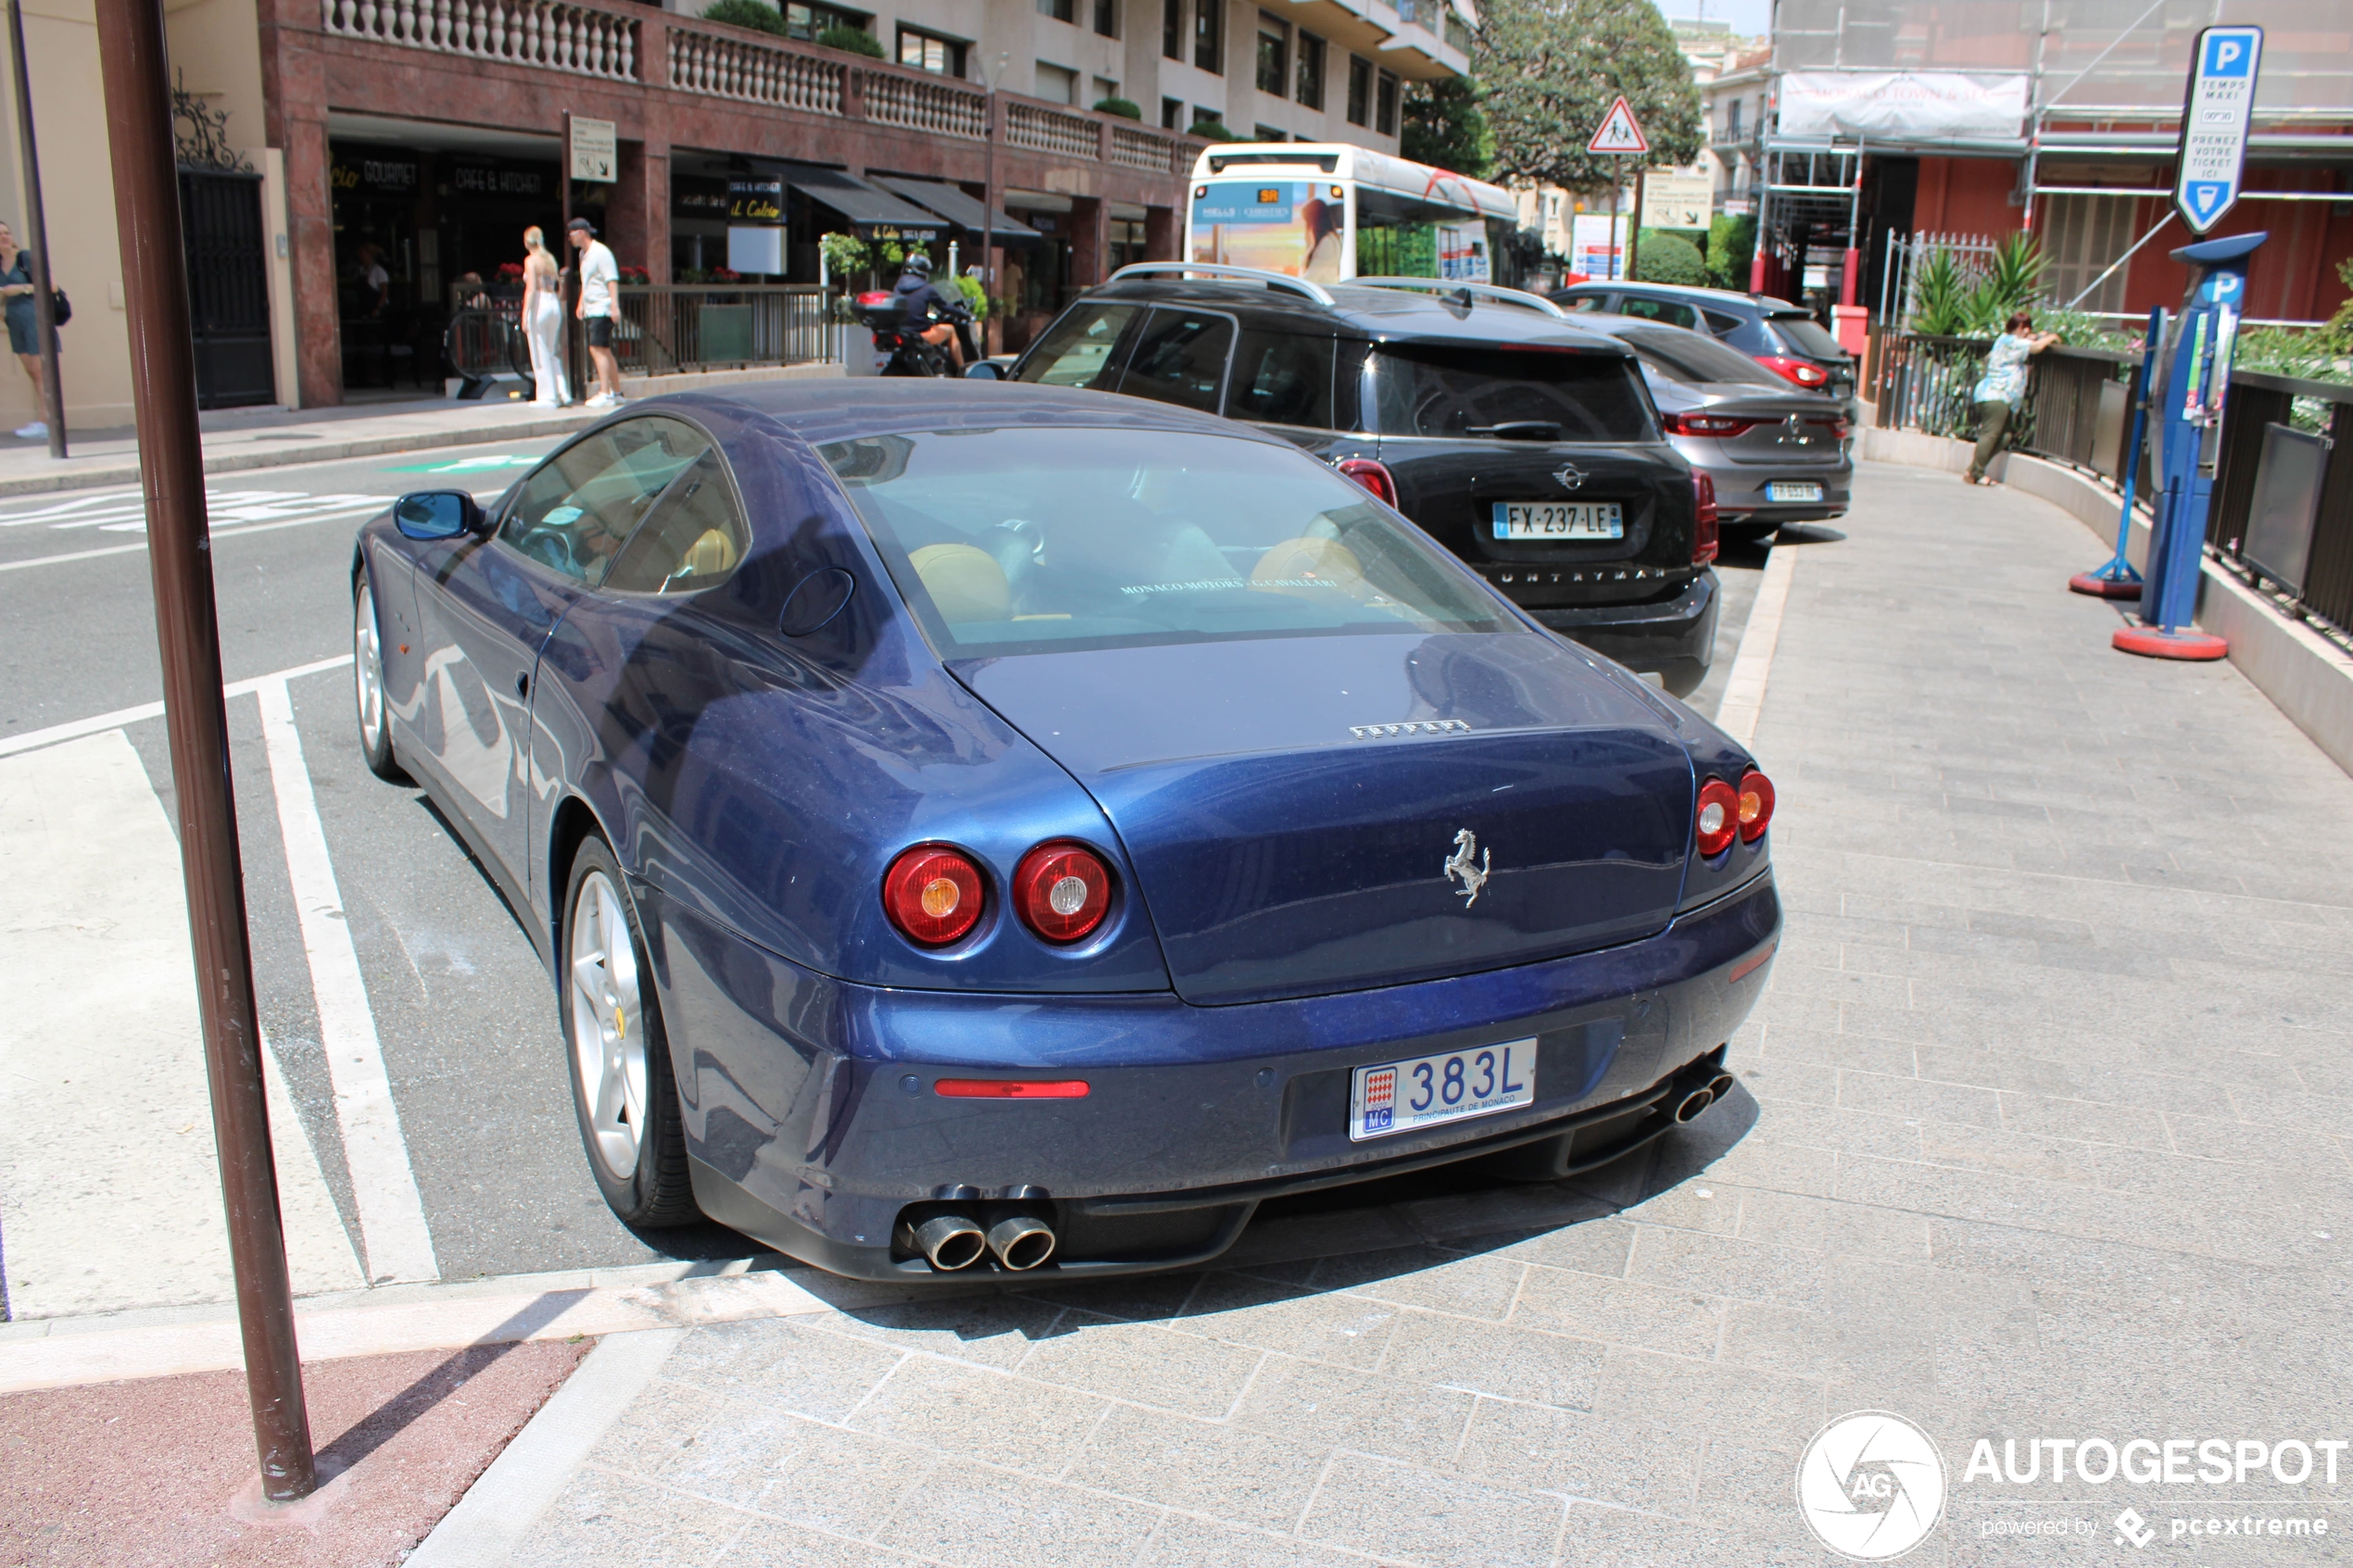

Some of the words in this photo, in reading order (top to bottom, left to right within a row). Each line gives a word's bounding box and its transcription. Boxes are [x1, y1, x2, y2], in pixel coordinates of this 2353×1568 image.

[2216, 42, 2241, 71] P
[2200, 80, 2246, 91] TEMPS
[1814, 87, 1886, 101] MONACO
[1892, 87, 1943, 101] TOWN
[1946, 88, 1957, 100] &
[2205, 91, 2239, 101] MAXI
[2191, 136, 2238, 145] PRENEZ
[2195, 147, 2232, 157] VOTRE
[2192, 158, 2233, 168] TICKET
[364, 160, 417, 184] GOURMET
[2202, 169, 2218, 179] ICI
[487, 170, 497, 192] &
[729, 182, 747, 193] CAFE
[747, 199, 780, 219] Calcio
[2212, 271, 2239, 303] P
[1120, 580, 1244, 595] MONACO-MOTORS
[1410, 1047, 1523, 1111] 383L
[1413, 1104, 1466, 1123] PRINCIPAUTE
[1468, 1102, 1479, 1111] DE
[1481, 1095, 1516, 1109] MONACO
[1368, 1110, 1389, 1128] MC
